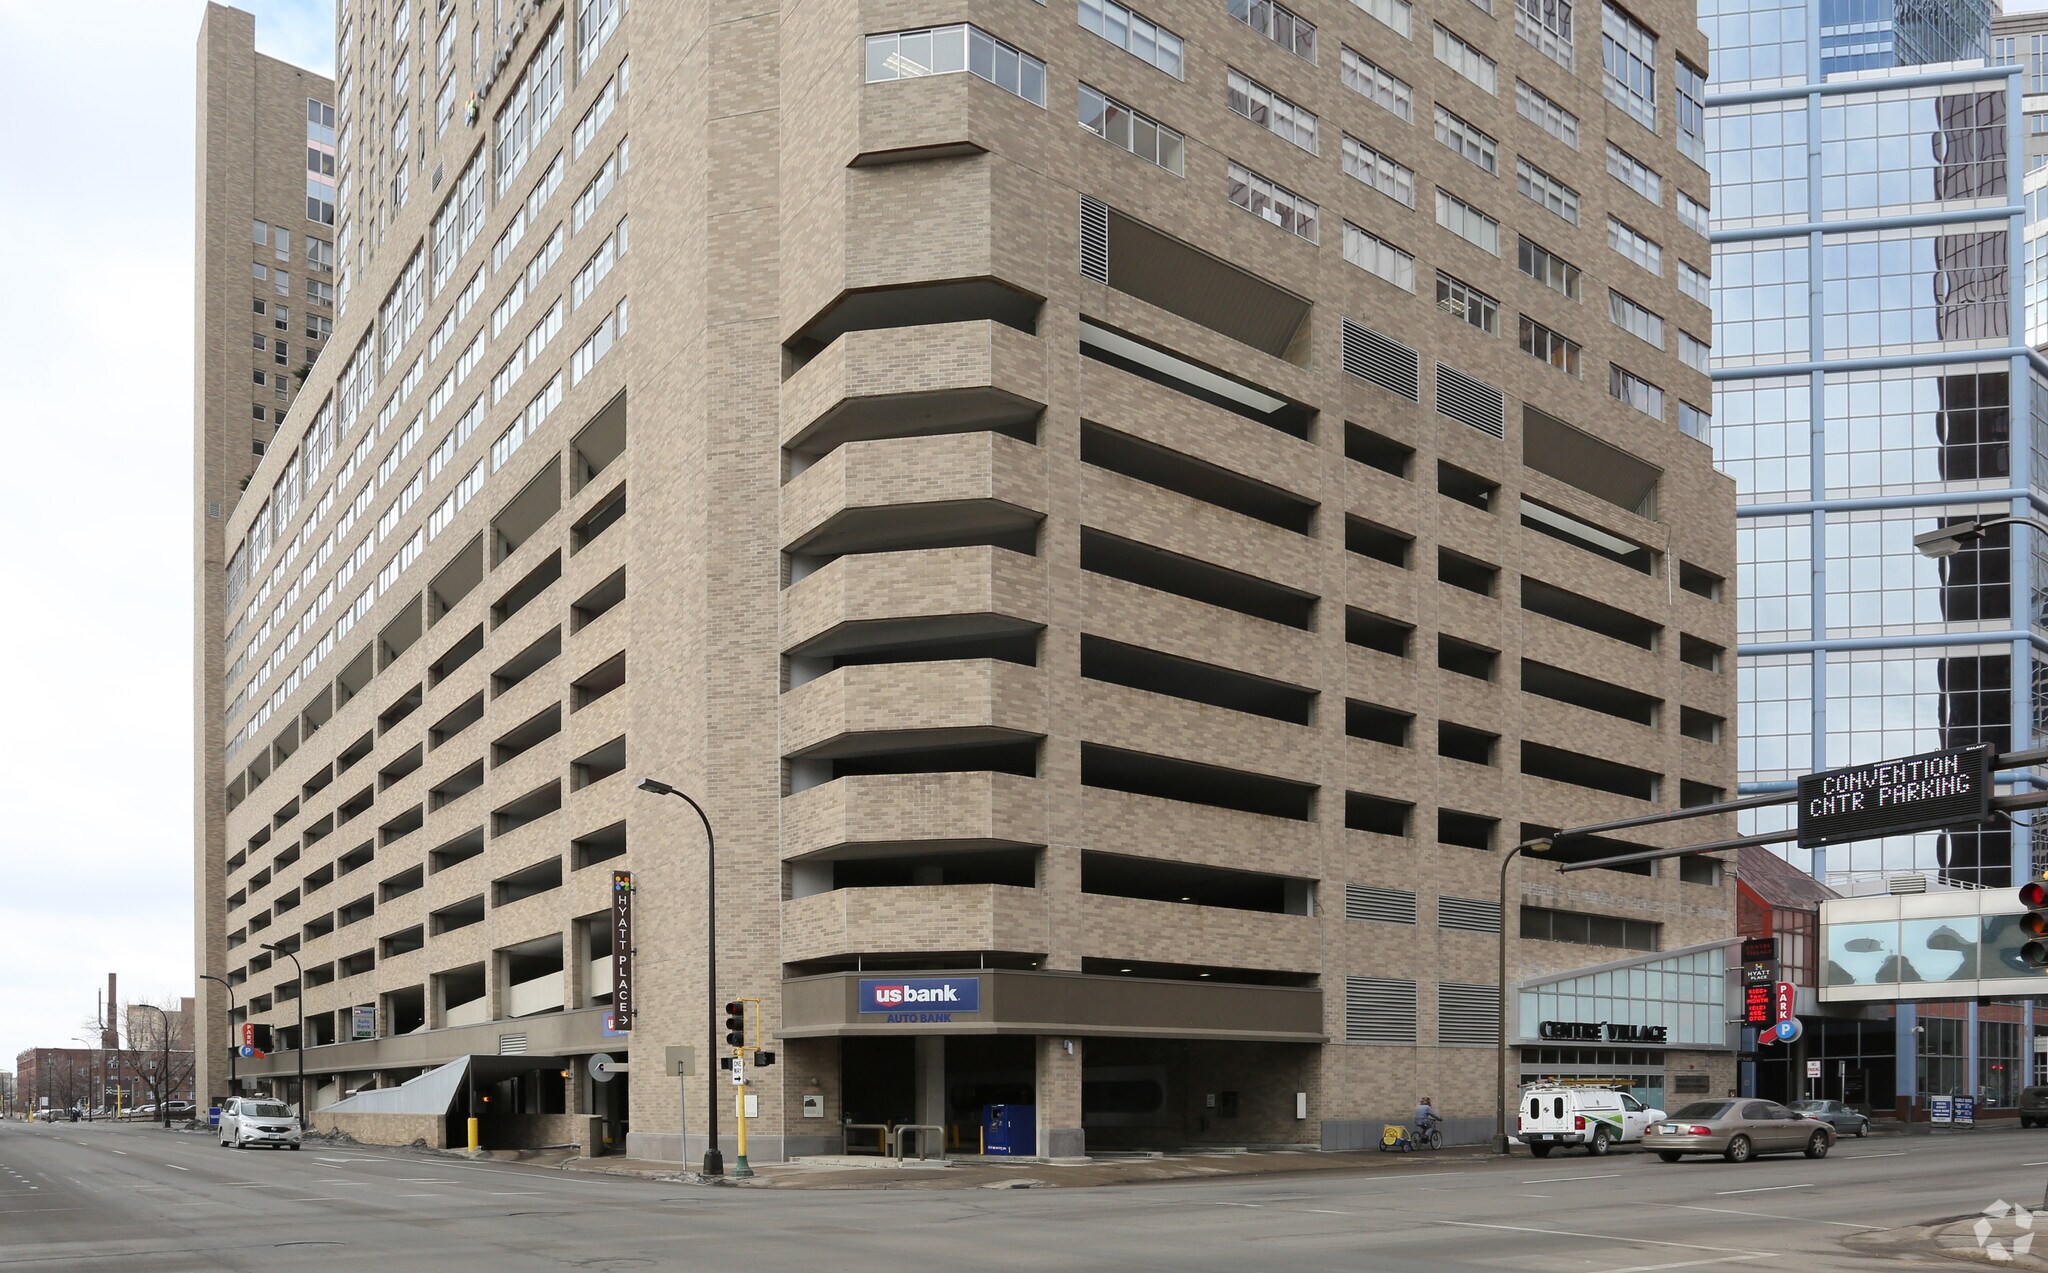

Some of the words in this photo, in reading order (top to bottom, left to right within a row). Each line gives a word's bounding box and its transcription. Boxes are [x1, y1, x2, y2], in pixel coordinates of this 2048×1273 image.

[1823, 754, 1959, 795] CONVENTION
[1810, 790, 1865, 817] CNTR
[1879, 774, 1970, 807] PARKING
[618, 895, 628, 950] HYATT
[619, 956, 628, 1011] PLACE
[1779, 985, 1787, 1018] PARK
[887, 1014, 917, 1023] AUTO
[920, 1014, 951, 1022] BANK
[1606, 1023, 1667, 1042] VILLAGE
[1781, 1024, 1791, 1035] P
